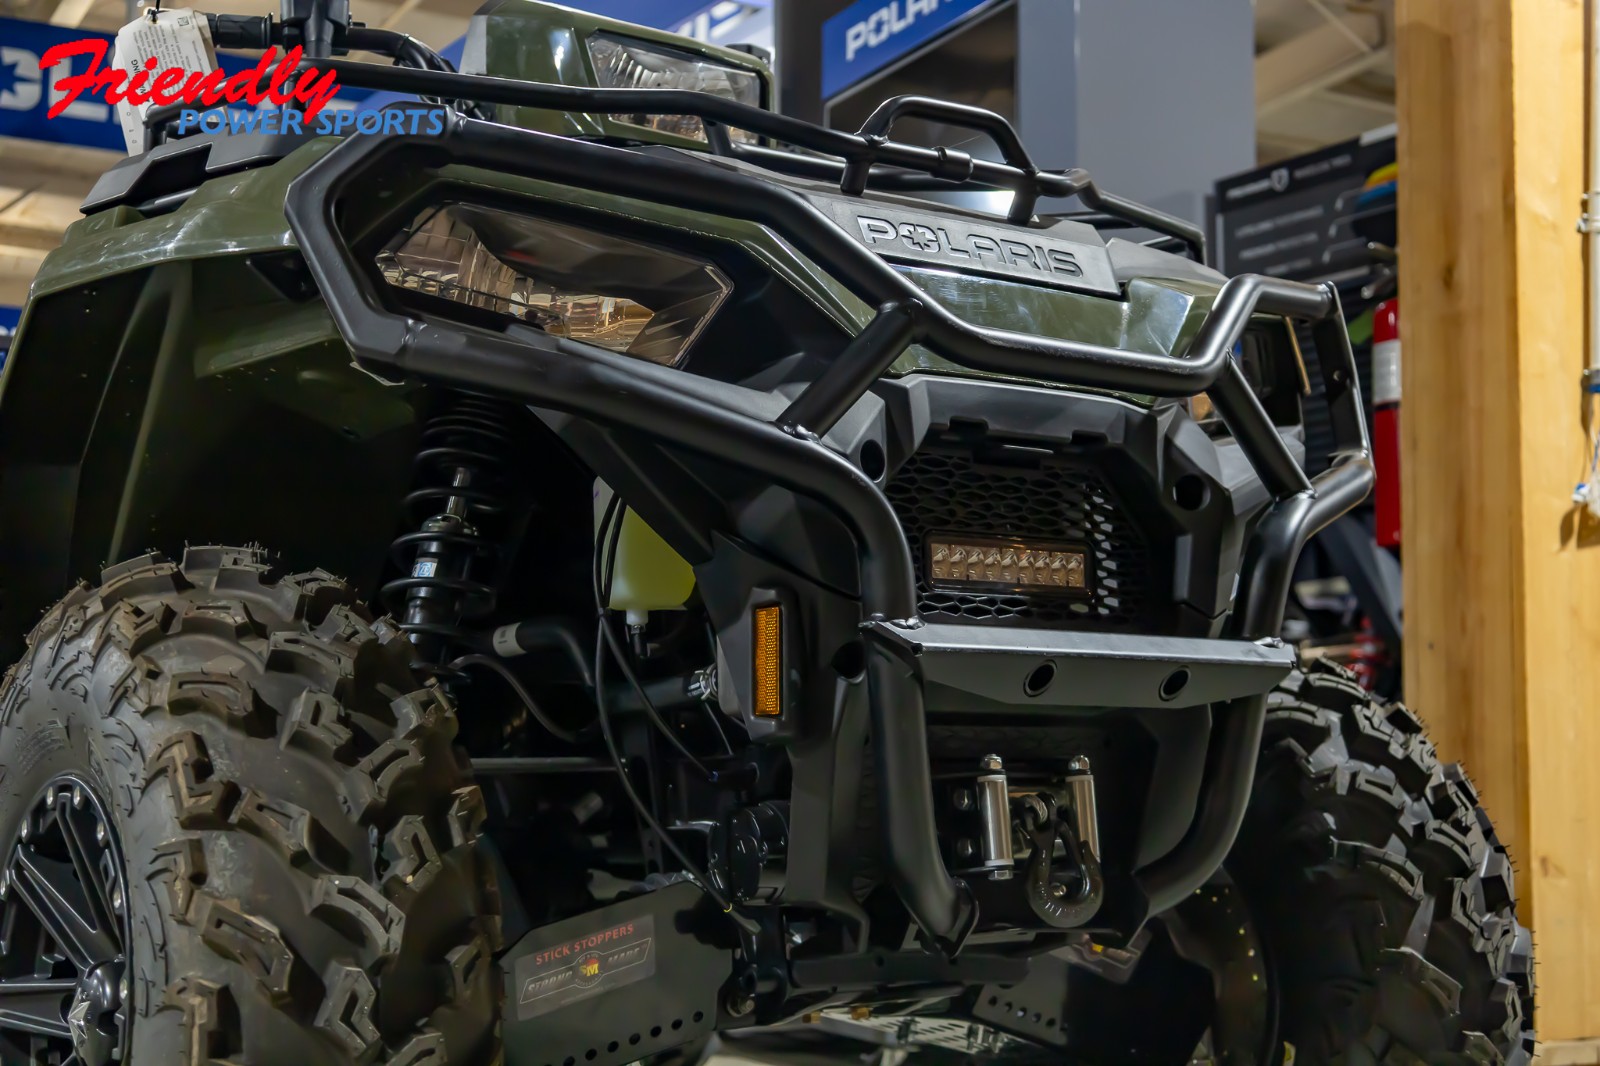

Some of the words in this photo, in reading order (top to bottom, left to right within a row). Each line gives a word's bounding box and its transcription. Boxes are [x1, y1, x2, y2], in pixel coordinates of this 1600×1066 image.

[845, 0, 942, 62] POLA
[857, 214, 1083, 278] POLARIS
[535, 944, 570, 966] STICK
[574, 923, 634, 953] STOPPERS
